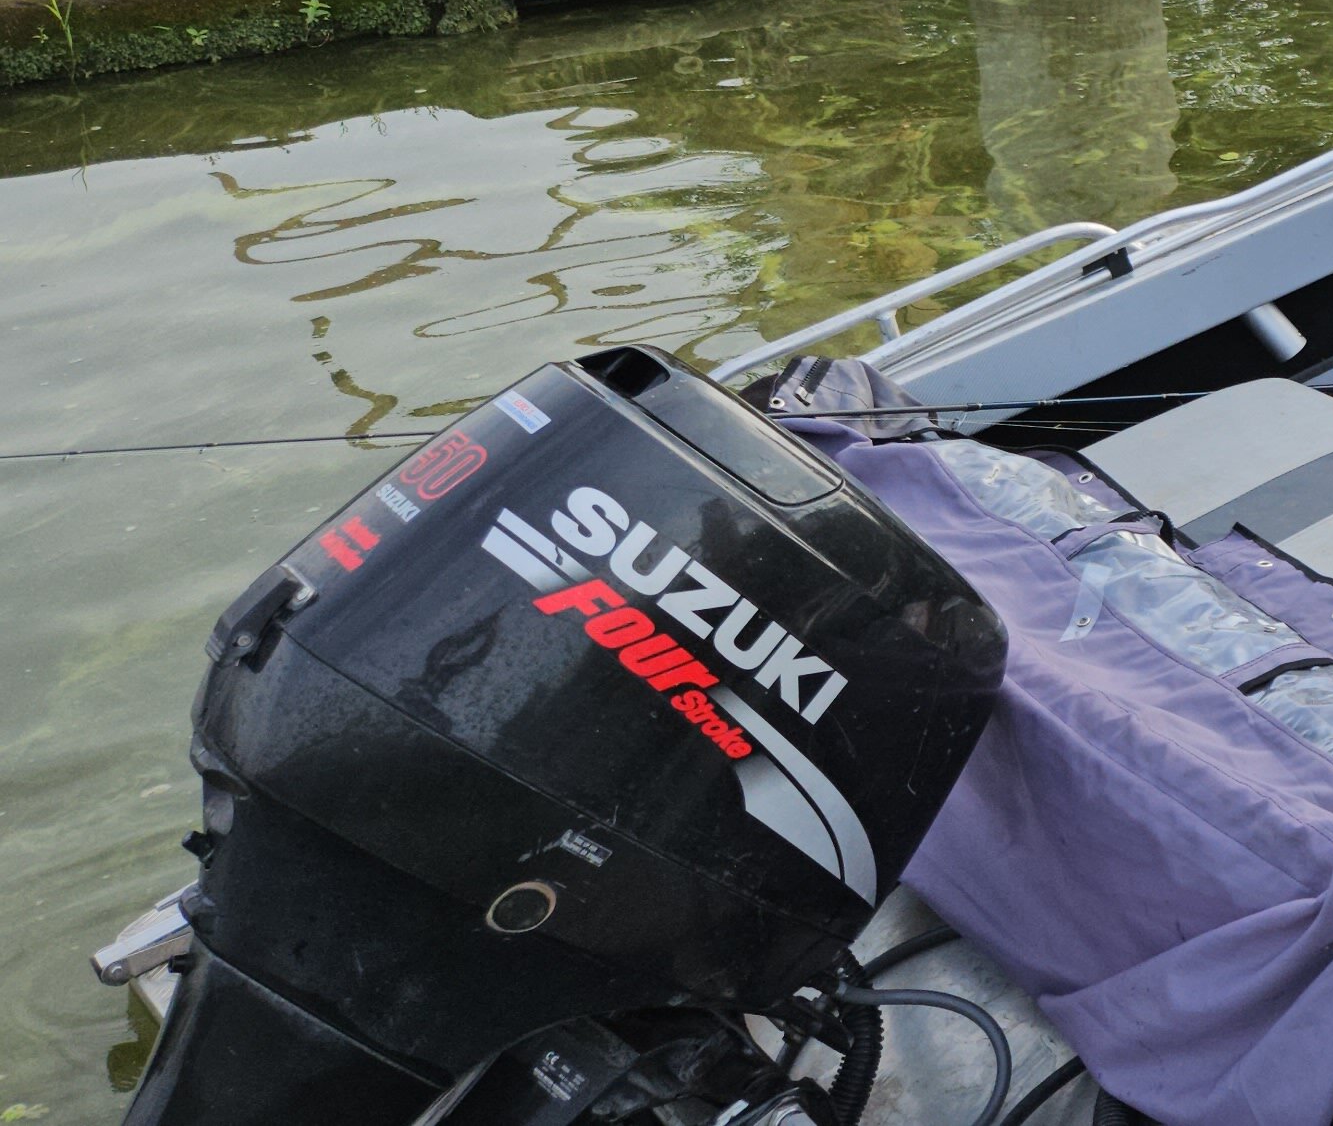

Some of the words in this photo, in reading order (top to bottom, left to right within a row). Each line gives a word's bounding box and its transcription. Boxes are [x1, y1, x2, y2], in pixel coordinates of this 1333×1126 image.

[401, 428, 487, 501] 50
[376, 483, 421, 523] SUZUKI
[551, 486, 849, 726] SUZUKI
[670, 689, 753, 759] Stroke
